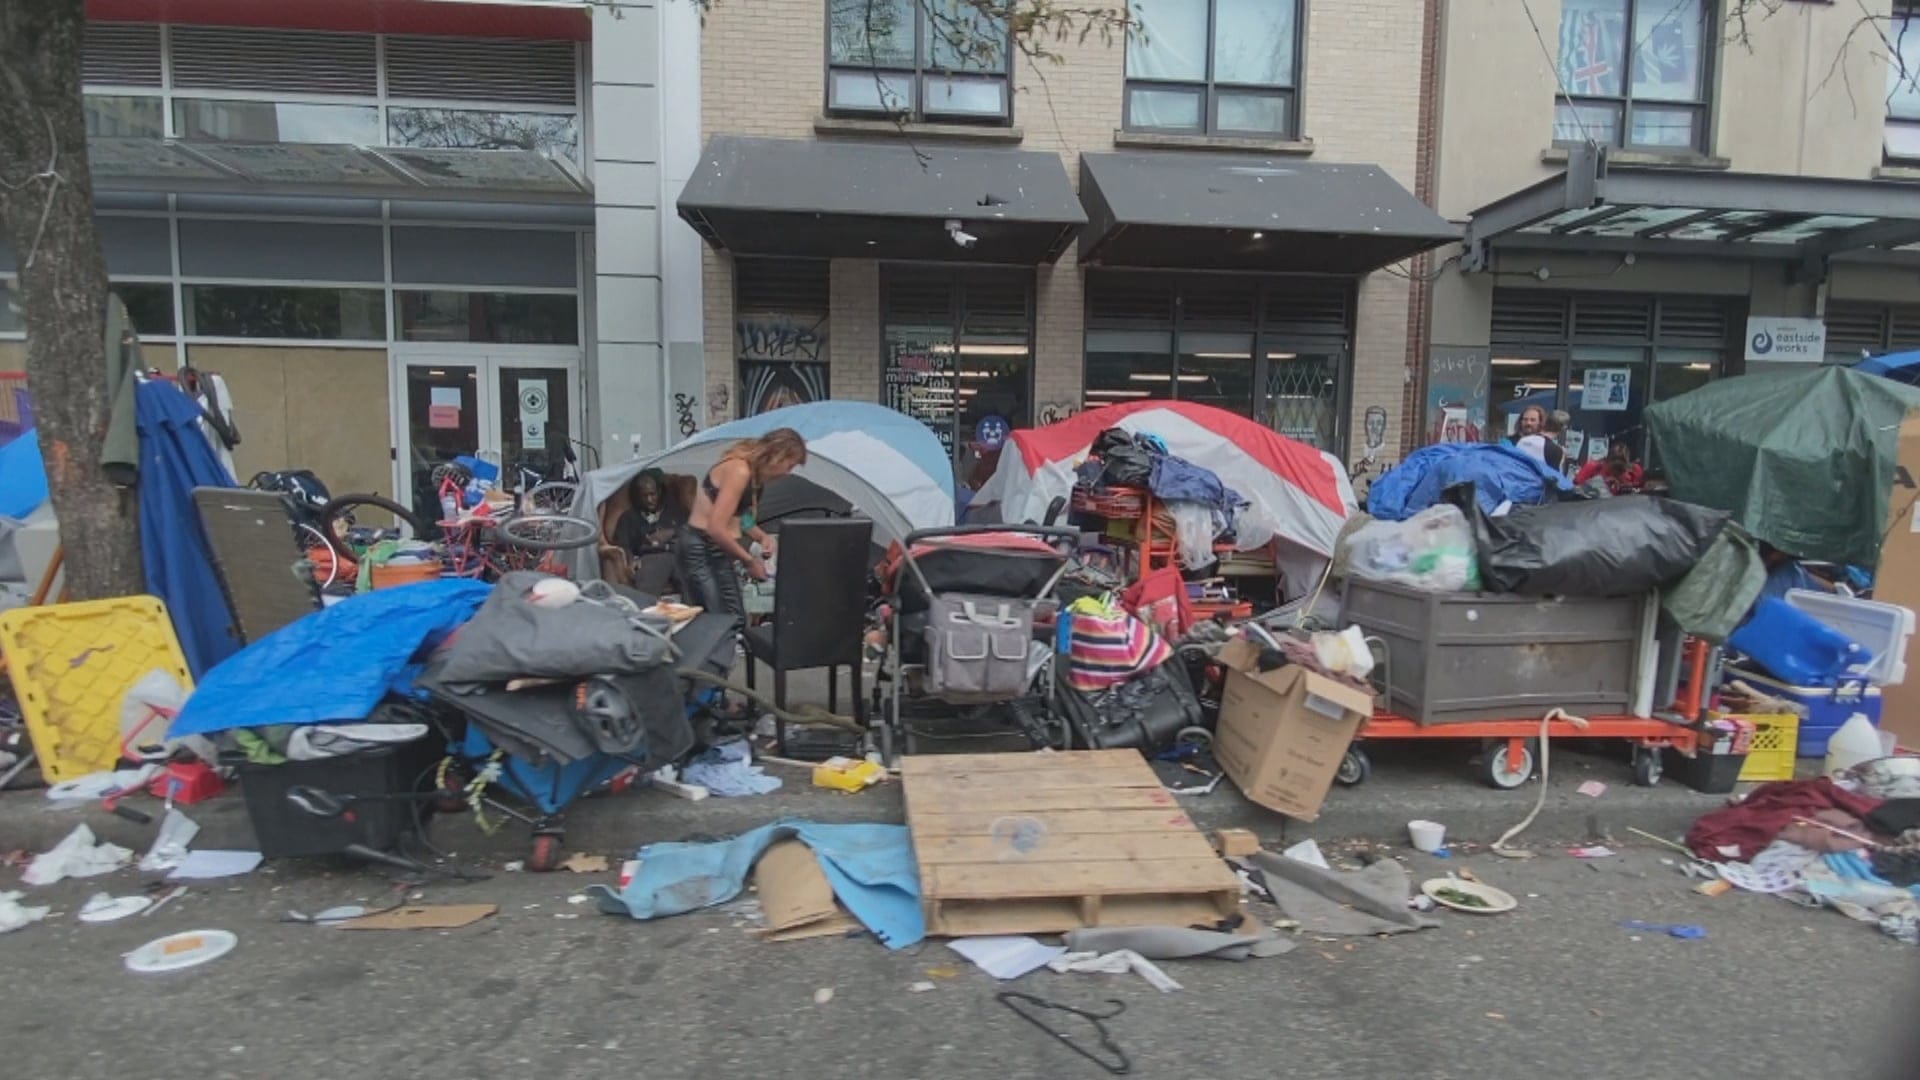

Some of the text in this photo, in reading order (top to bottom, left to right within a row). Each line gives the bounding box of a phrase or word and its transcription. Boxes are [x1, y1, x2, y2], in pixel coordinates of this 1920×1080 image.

[1776, 333, 1820, 343] eastside
[1776, 345, 1808, 353] works
[886, 373, 928, 385] money
[929, 377, 950, 389] job
[1513, 384, 1530, 398] 57
